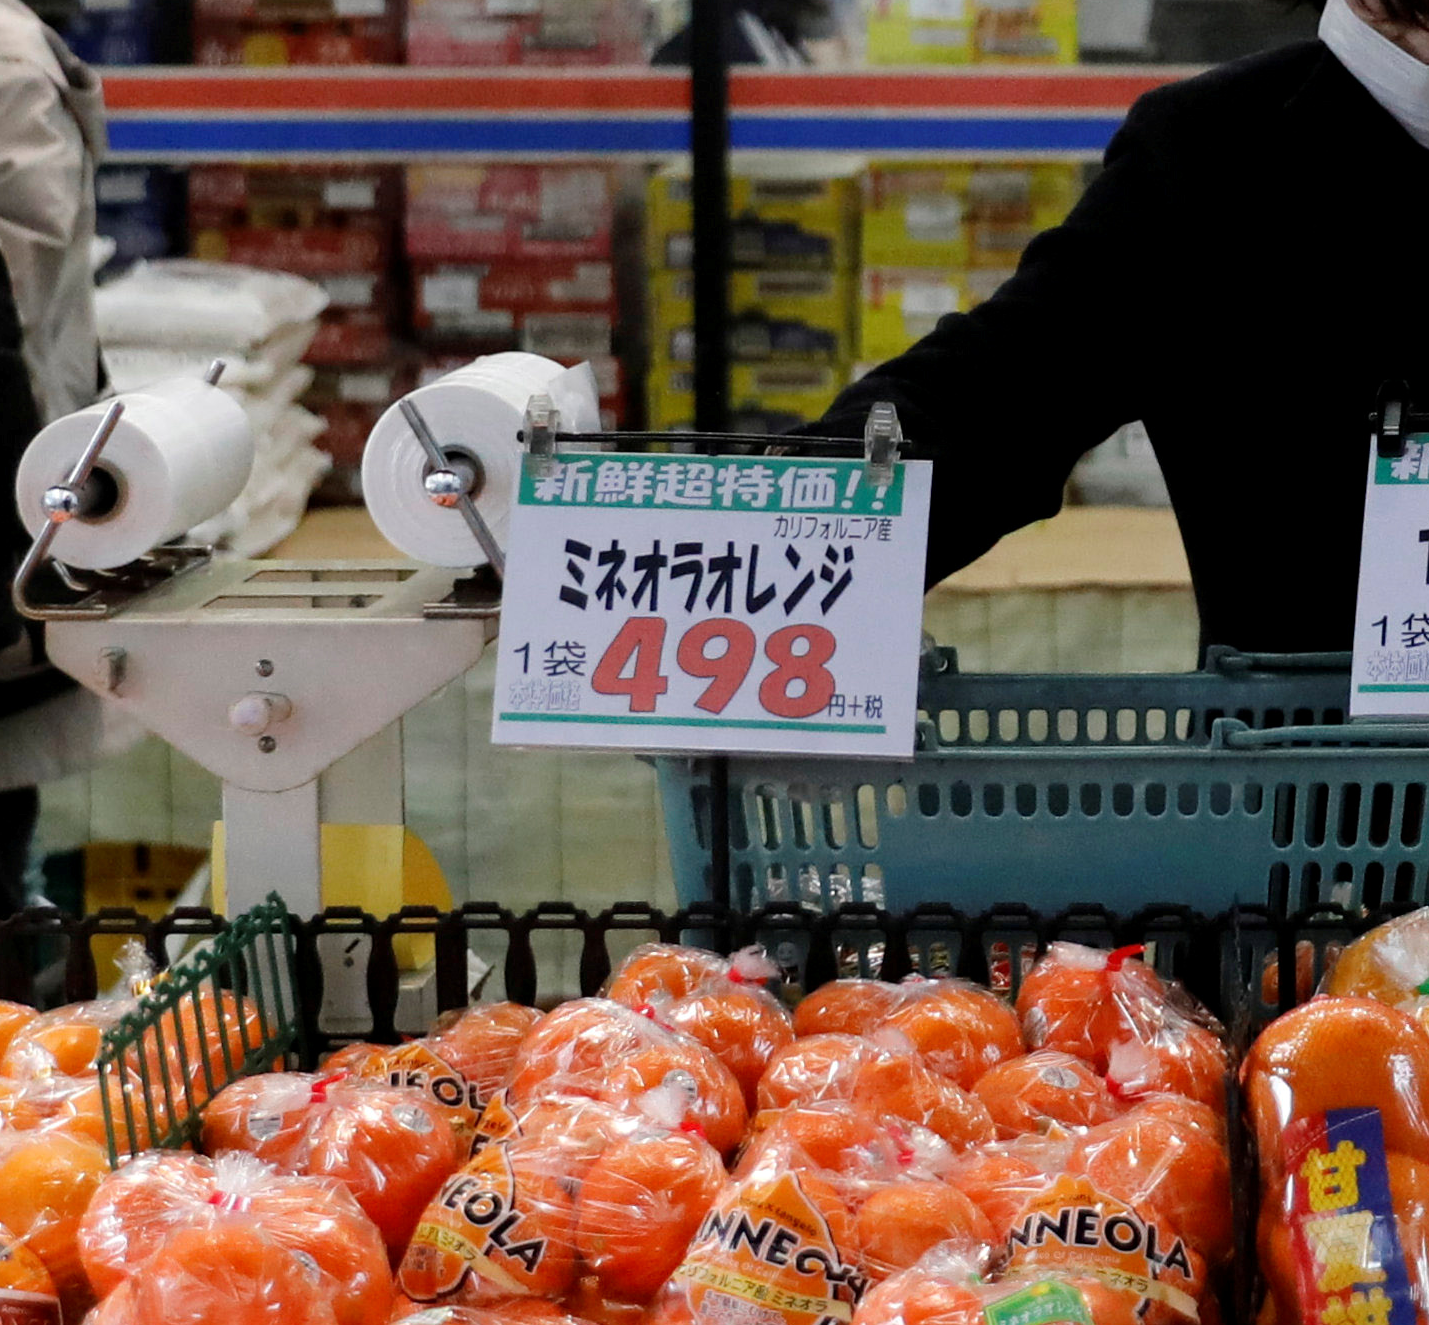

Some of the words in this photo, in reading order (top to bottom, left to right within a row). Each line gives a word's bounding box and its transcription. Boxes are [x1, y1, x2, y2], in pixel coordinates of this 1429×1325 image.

[774, 516, 893, 541] カリフォルニア産
[559, 538, 854, 616] ミネオラオレンジ
[513, 640, 587, 676] 1袋
[591, 616, 837, 719] 498
[441, 1176, 548, 1274] EOLA
[771, 1291, 829, 1313] ミネオラ
